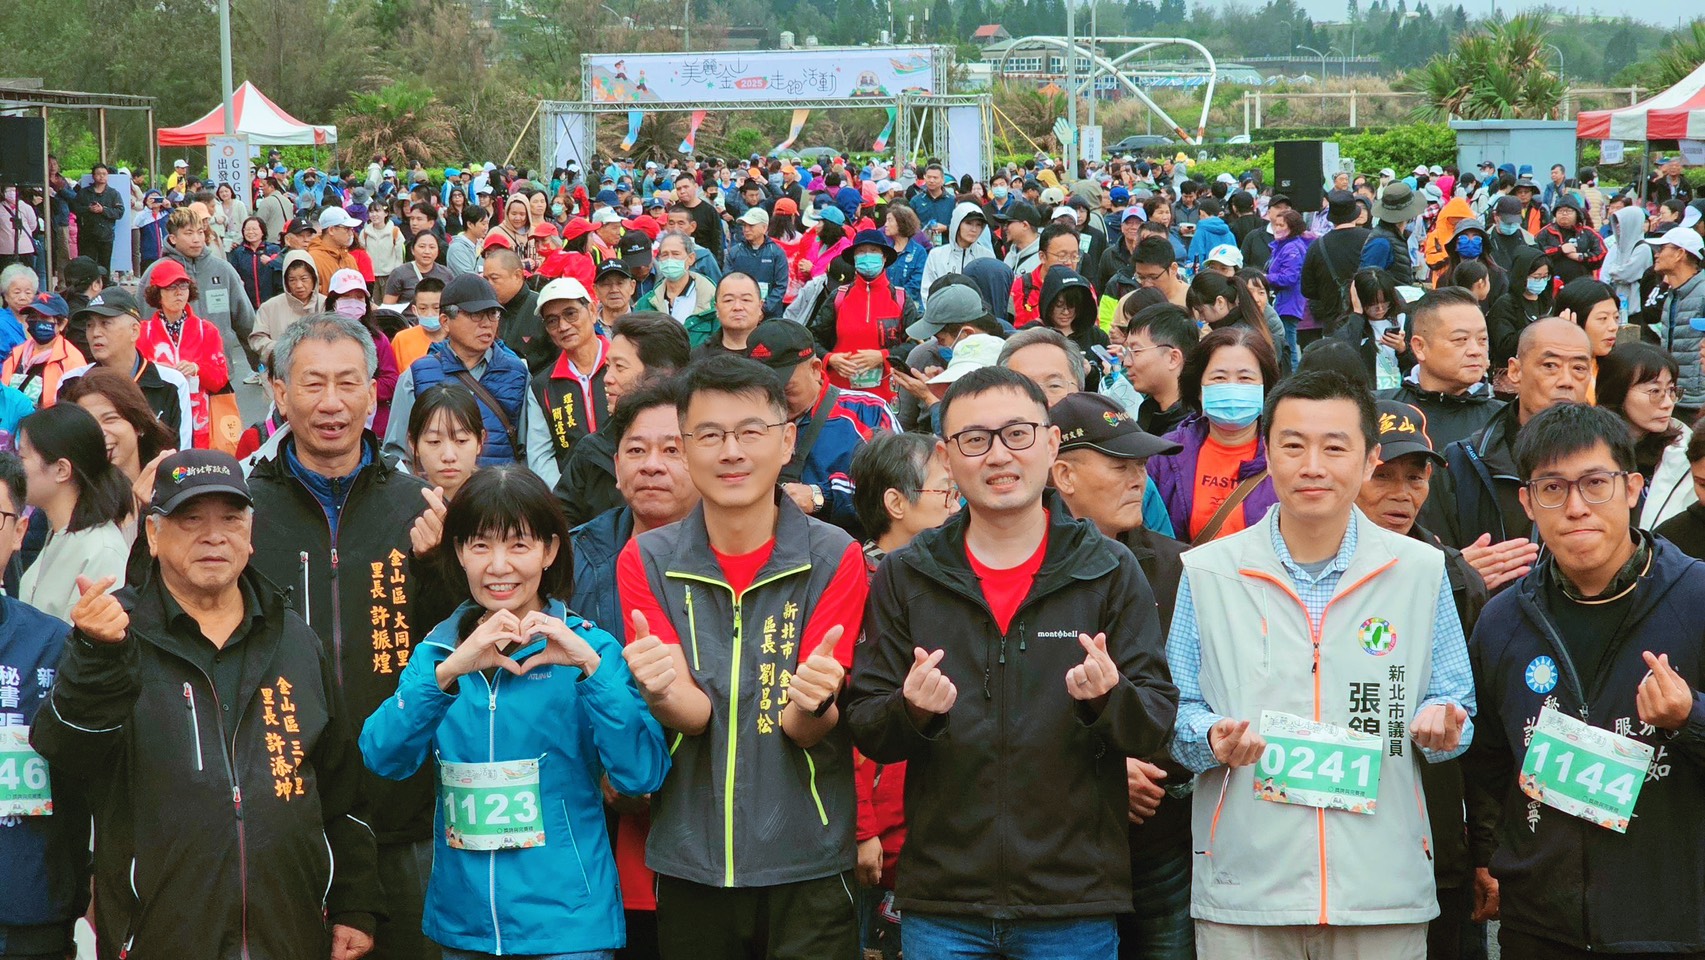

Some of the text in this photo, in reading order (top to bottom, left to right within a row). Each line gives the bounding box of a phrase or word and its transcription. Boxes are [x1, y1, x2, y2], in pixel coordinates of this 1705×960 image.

[741, 80, 763, 88] 2025
[218, 158, 228, 187] 出發
[563, 393, 577, 428] 理事長
[1379, 413, 1416, 434] 金山
[187, 464, 230, 476] 新北市政府
[370, 562, 393, 674] 里長 許振煌
[388, 548, 410, 667] 金山區 大同里
[757, 615, 777, 735] 區長 劉昌松
[777, 601, 798, 727] 新北市 金山
[261, 687, 279, 726] 里長
[276, 676, 300, 733] 金山區
[1388, 665, 1405, 757] 新北市議員
[1260, 743, 1371, 787] 0241
[1532, 741, 1636, 805] 1144
[444, 791, 538, 825] 1123
